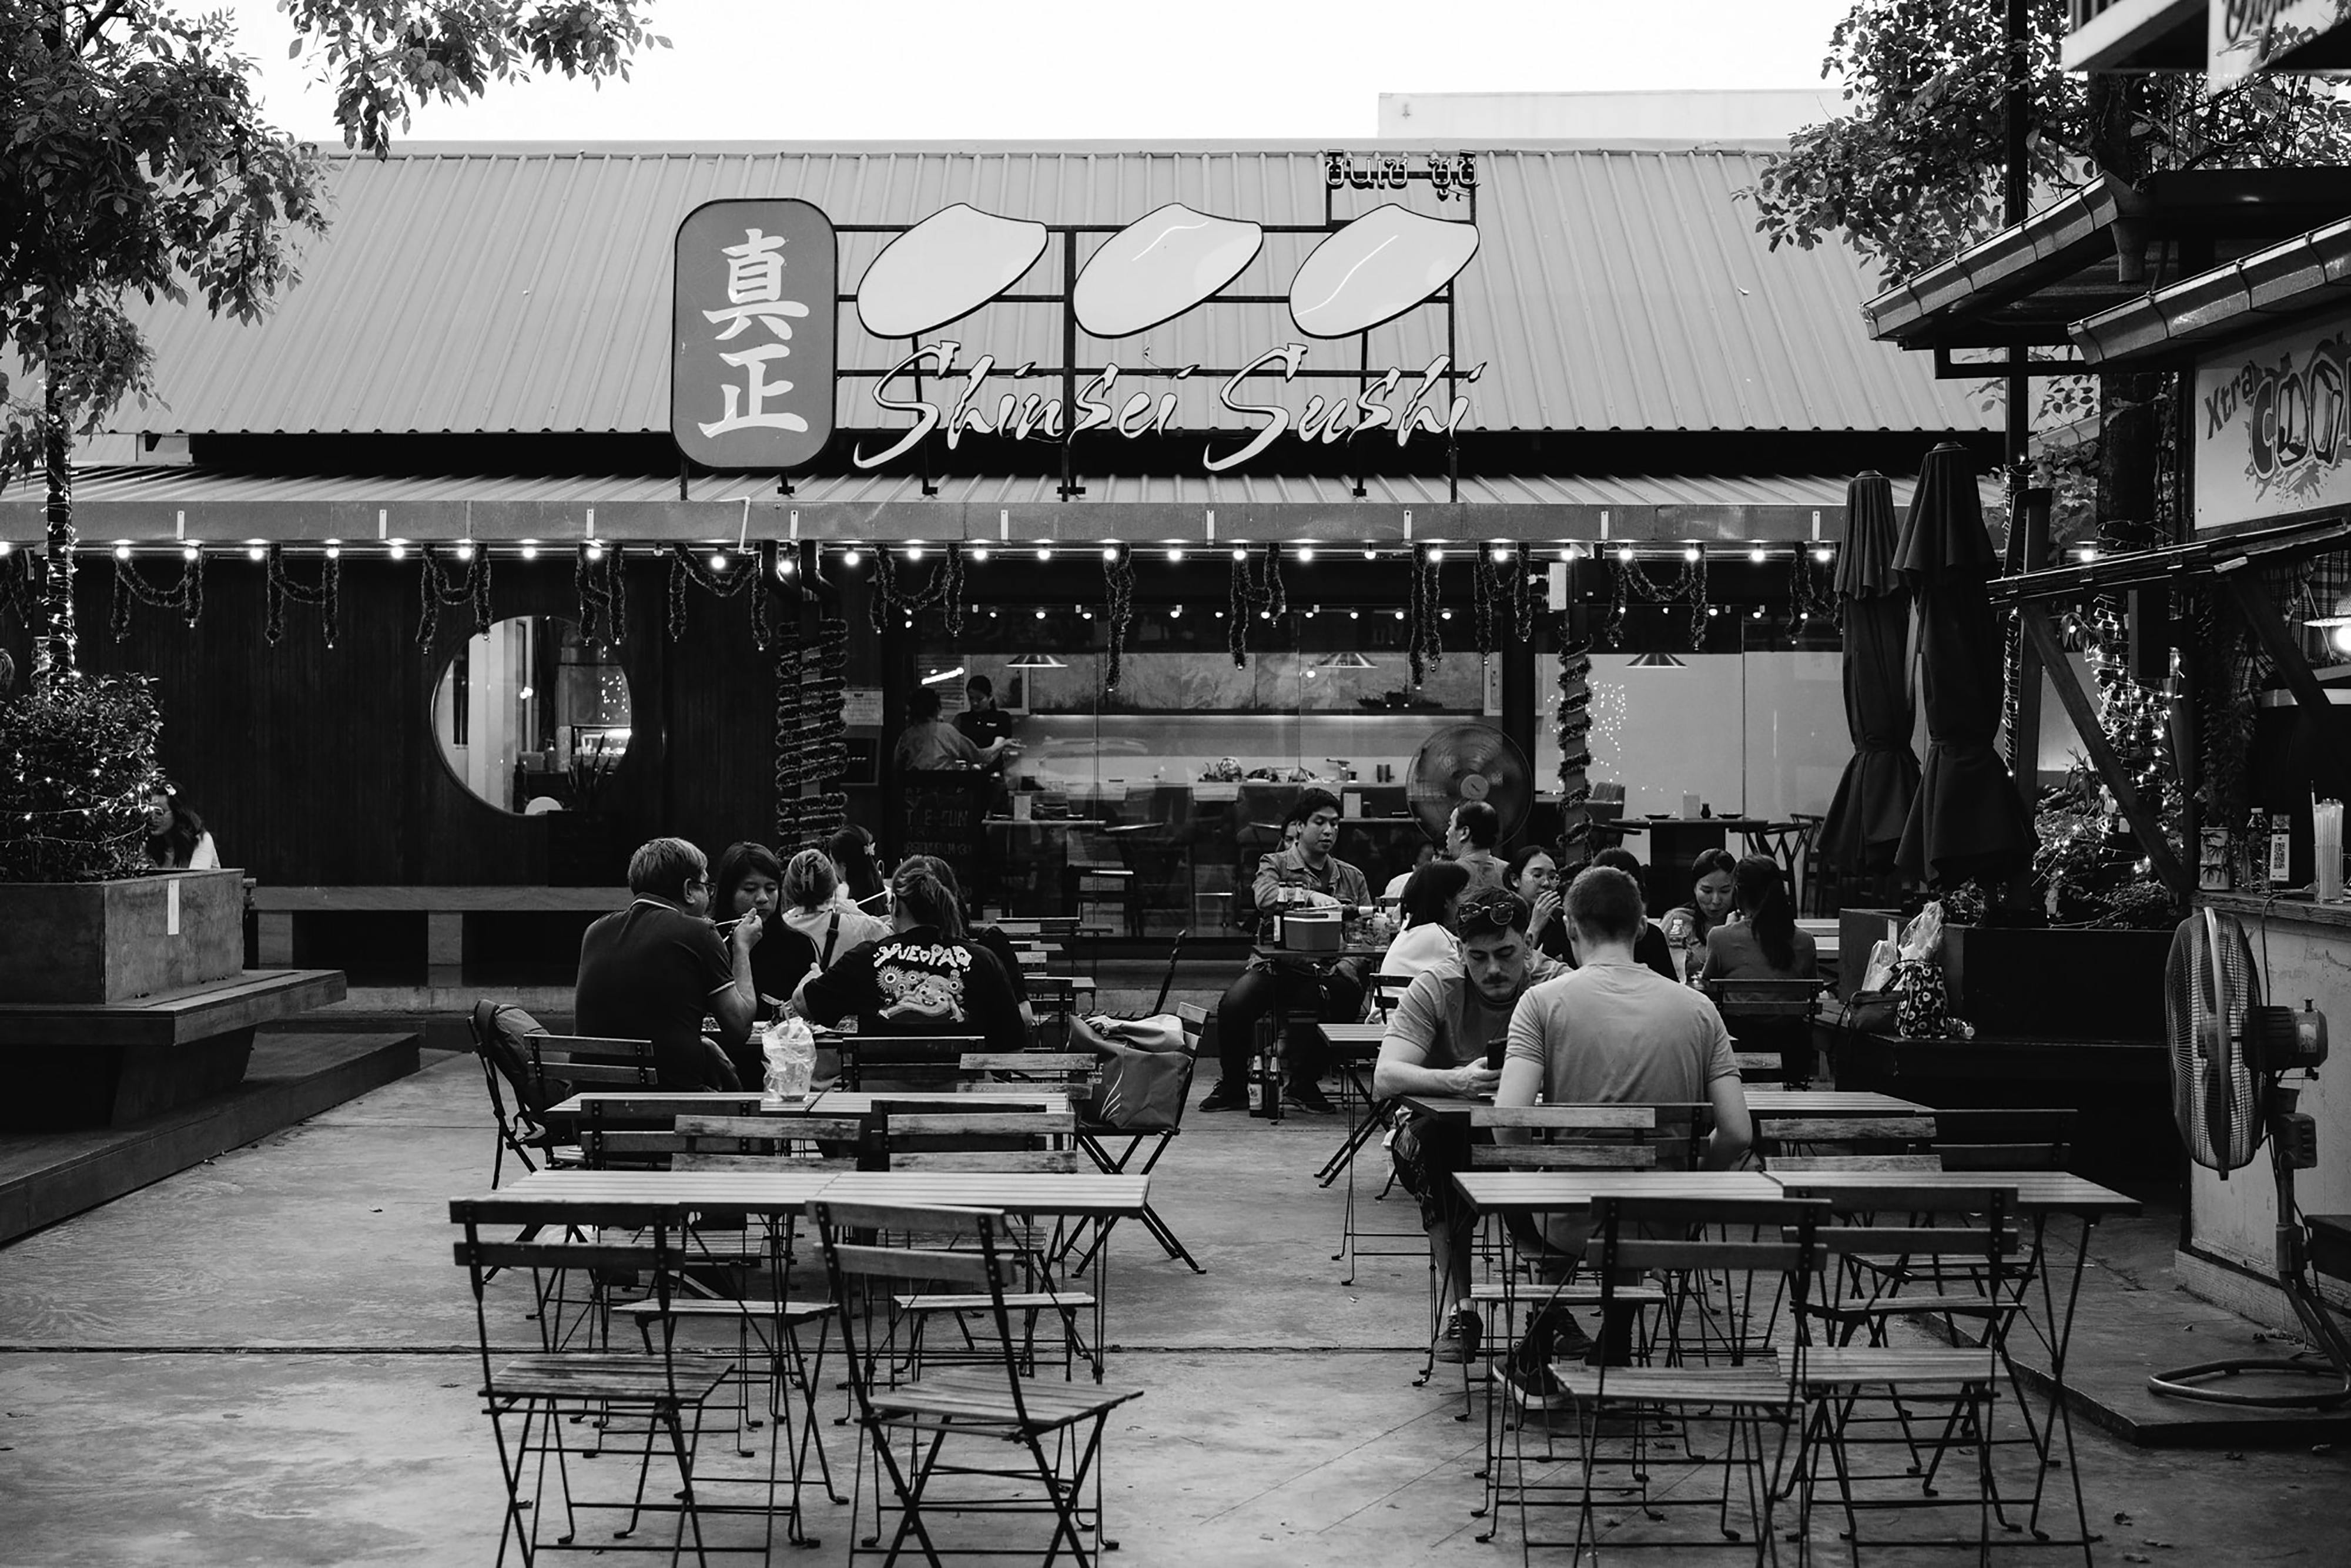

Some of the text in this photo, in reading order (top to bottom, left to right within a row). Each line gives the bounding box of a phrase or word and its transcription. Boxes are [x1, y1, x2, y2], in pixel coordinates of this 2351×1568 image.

[698, 228, 809, 438] 真正
[853, 340, 1488, 471] Shinsei Sushi
[2203, 363, 2255, 440] Xtra
